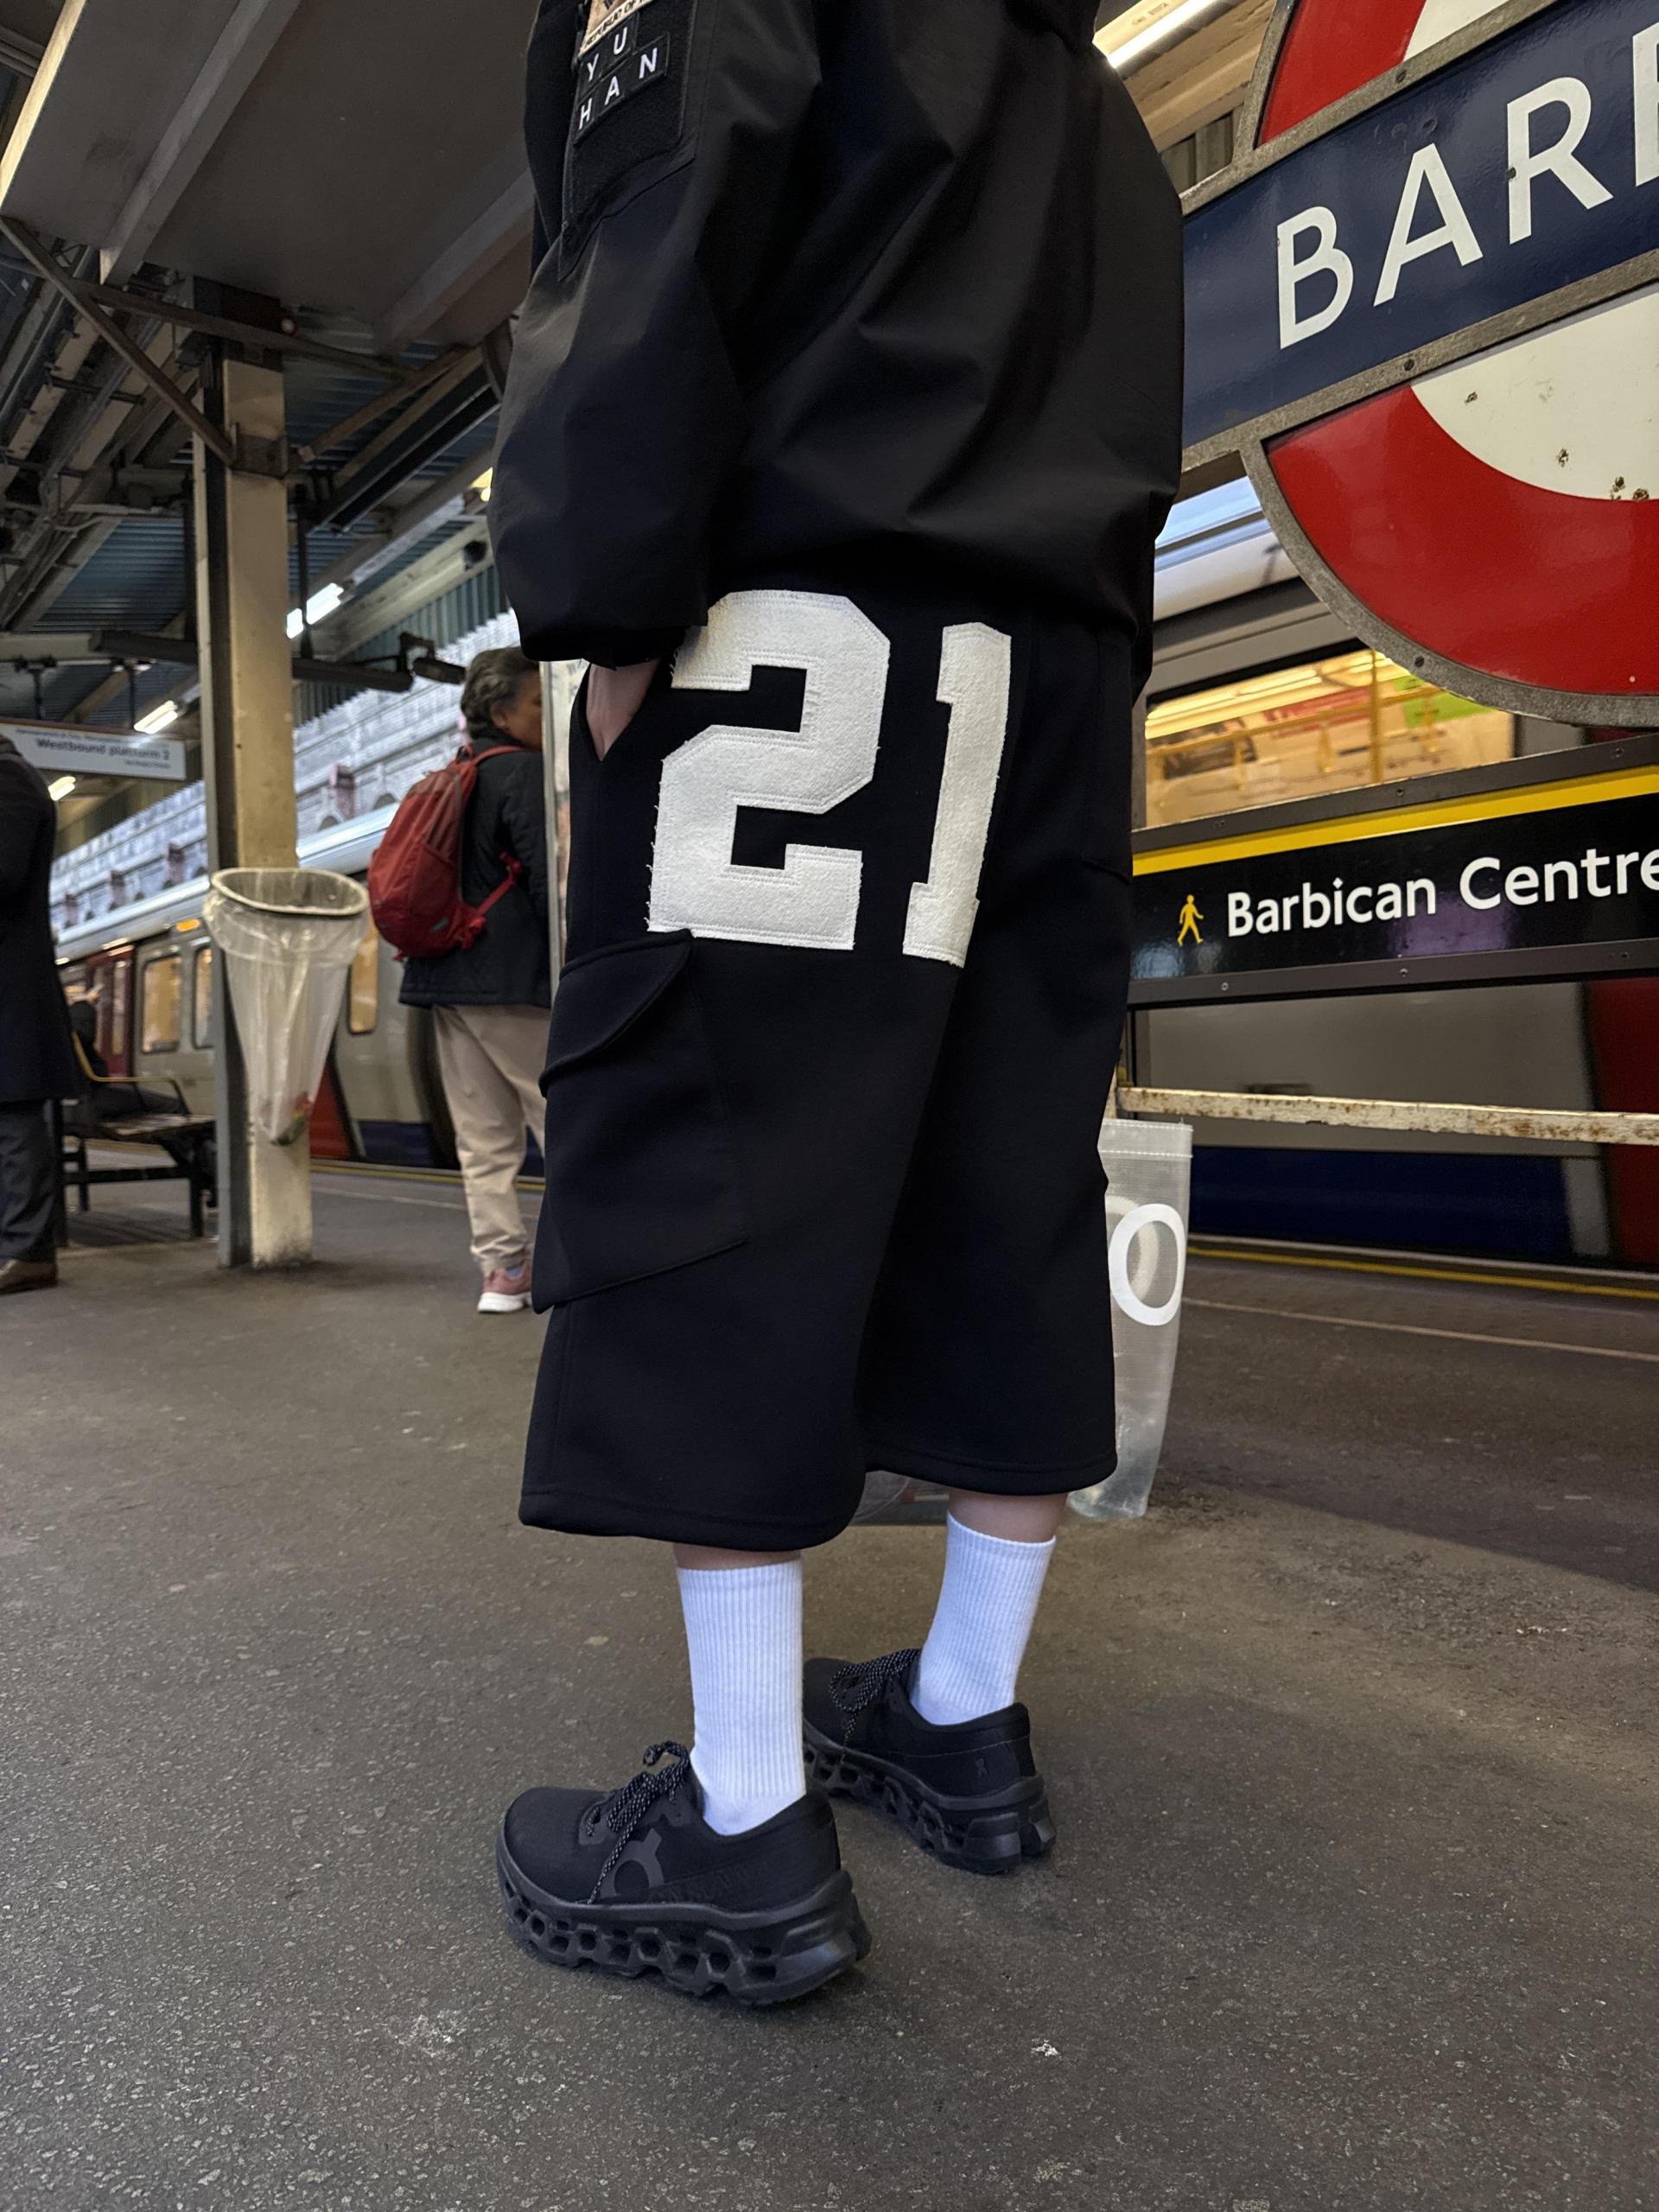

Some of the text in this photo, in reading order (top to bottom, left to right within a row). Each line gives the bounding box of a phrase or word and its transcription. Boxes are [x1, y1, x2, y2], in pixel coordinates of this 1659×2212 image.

[587, 28, 628, 82] YU
[578, 48, 658, 130] HAN
[35, 737, 106, 754] Westbound
[109, 745, 162, 760] platform
[645, 588, 1012, 969] 21
[1226, 877, 1437, 938] Barbican
